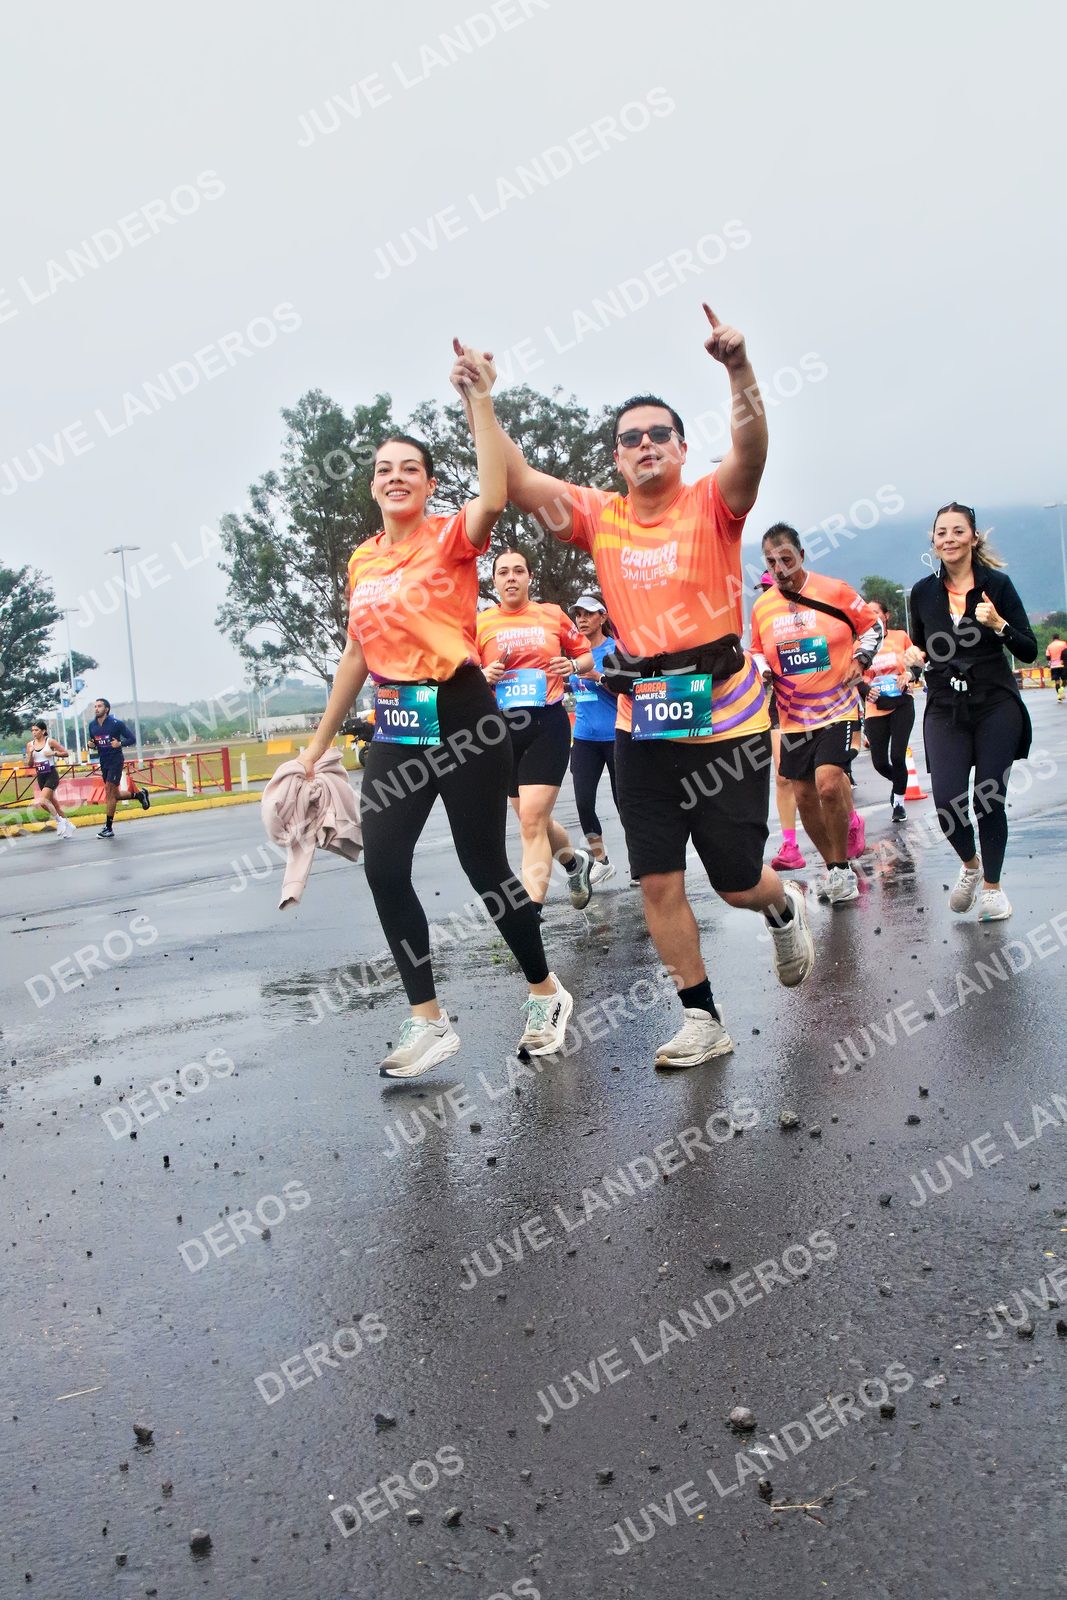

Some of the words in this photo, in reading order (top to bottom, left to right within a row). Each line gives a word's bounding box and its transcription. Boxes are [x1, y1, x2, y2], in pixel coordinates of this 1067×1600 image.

[621, 541, 677, 567] CARRERA
[788, 652, 817, 666] 1065
[505, 684, 537, 697] 2035
[635, 681, 666, 694] CARRERA
[690, 680, 705, 692] 10K
[416, 690, 430, 703] 10K
[644, 701, 693, 721] 1003
[384, 709, 419, 728] 1002
